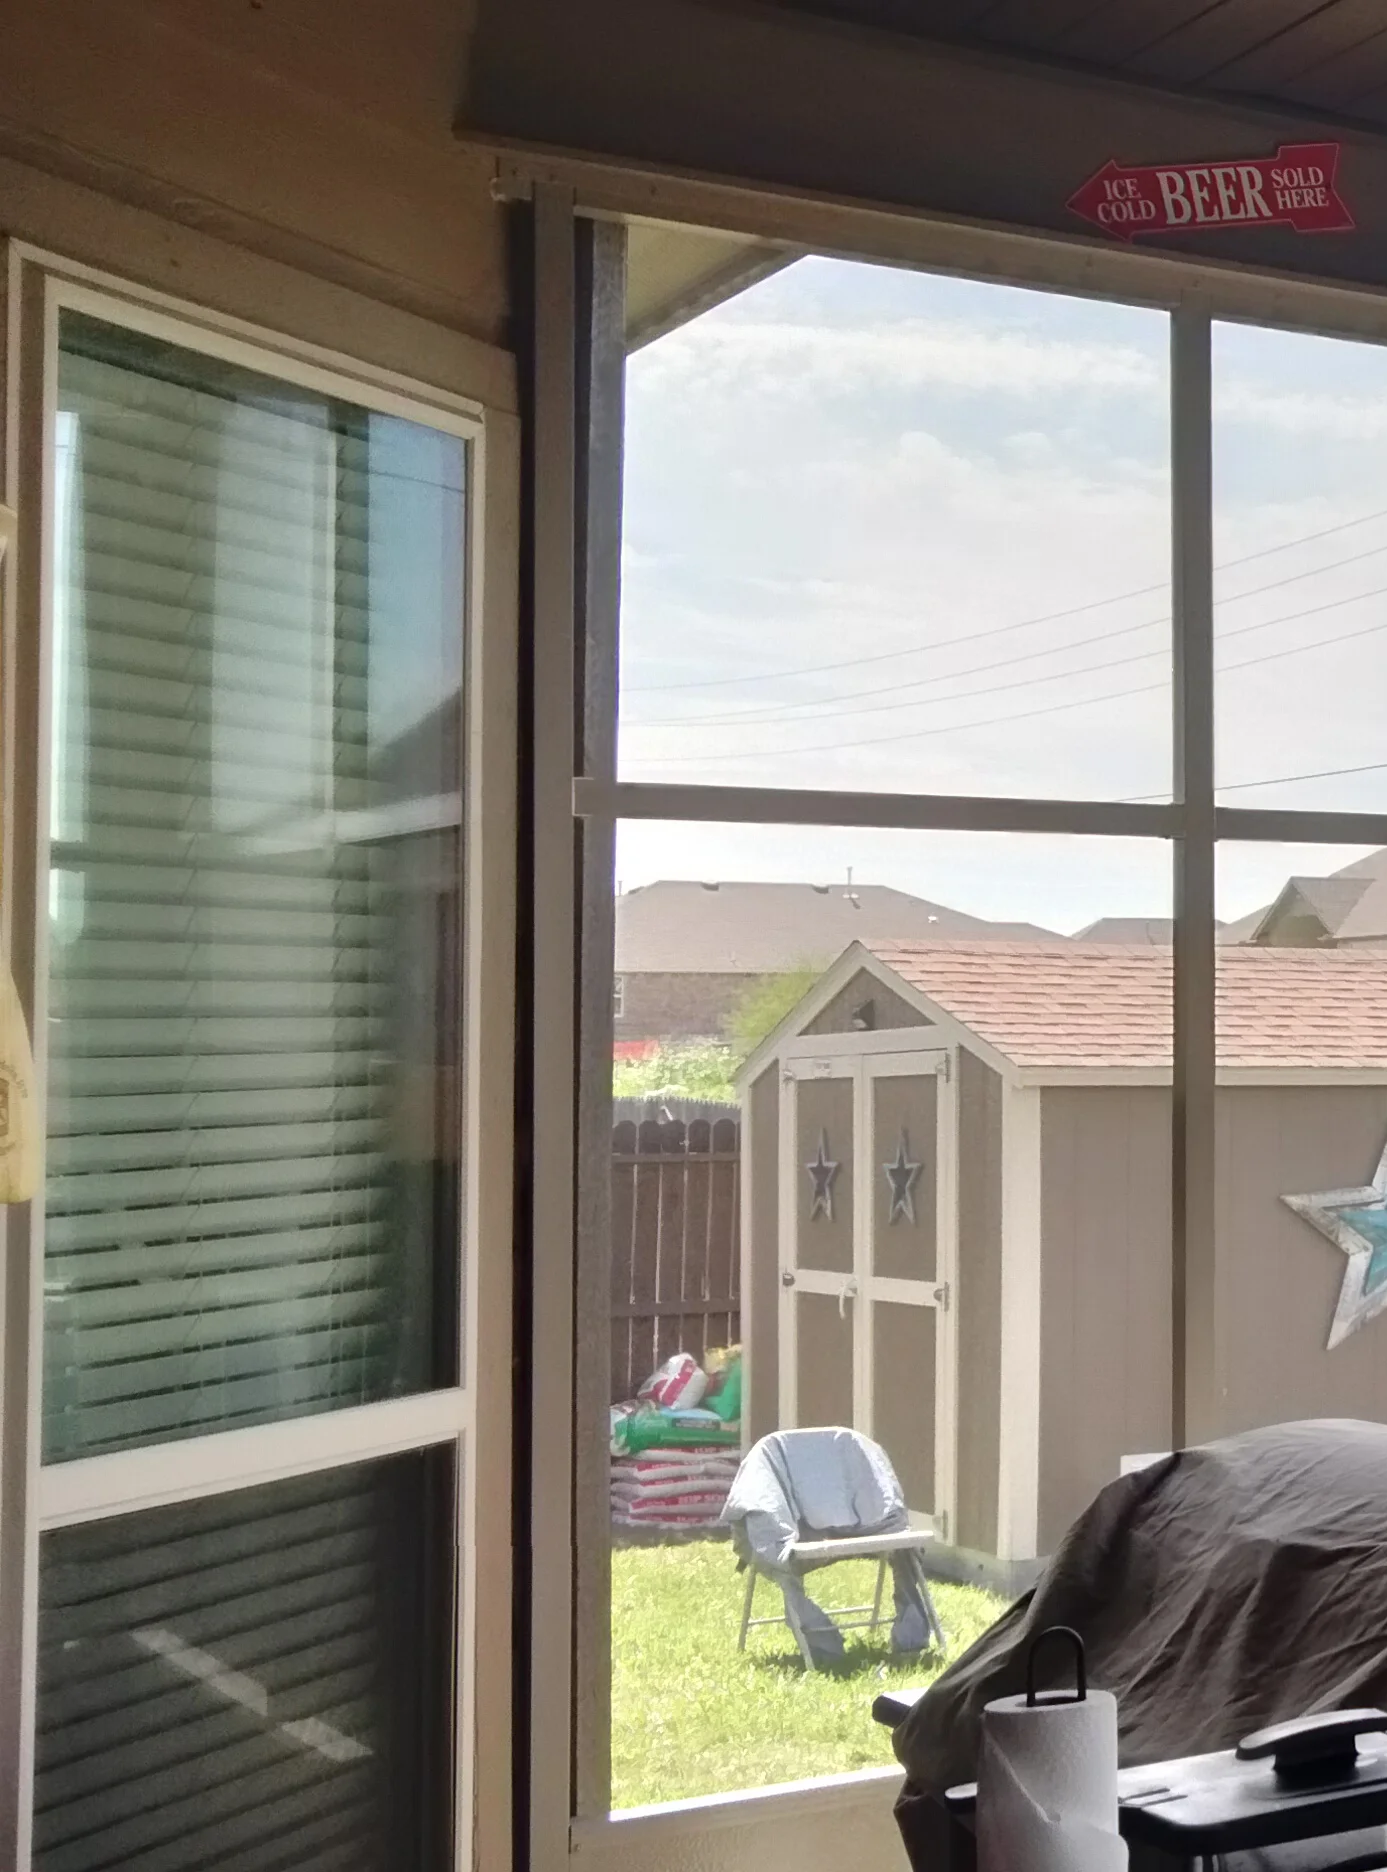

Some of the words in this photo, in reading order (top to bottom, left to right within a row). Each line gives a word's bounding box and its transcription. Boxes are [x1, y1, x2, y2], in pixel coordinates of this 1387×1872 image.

[1103, 178, 1142, 200] ICE
[1270, 166, 1324, 189] SOLD
[1156, 166, 1273, 225] BEER
[1275, 187, 1329, 210] HERE
[1097, 199, 1155, 224] COLD
